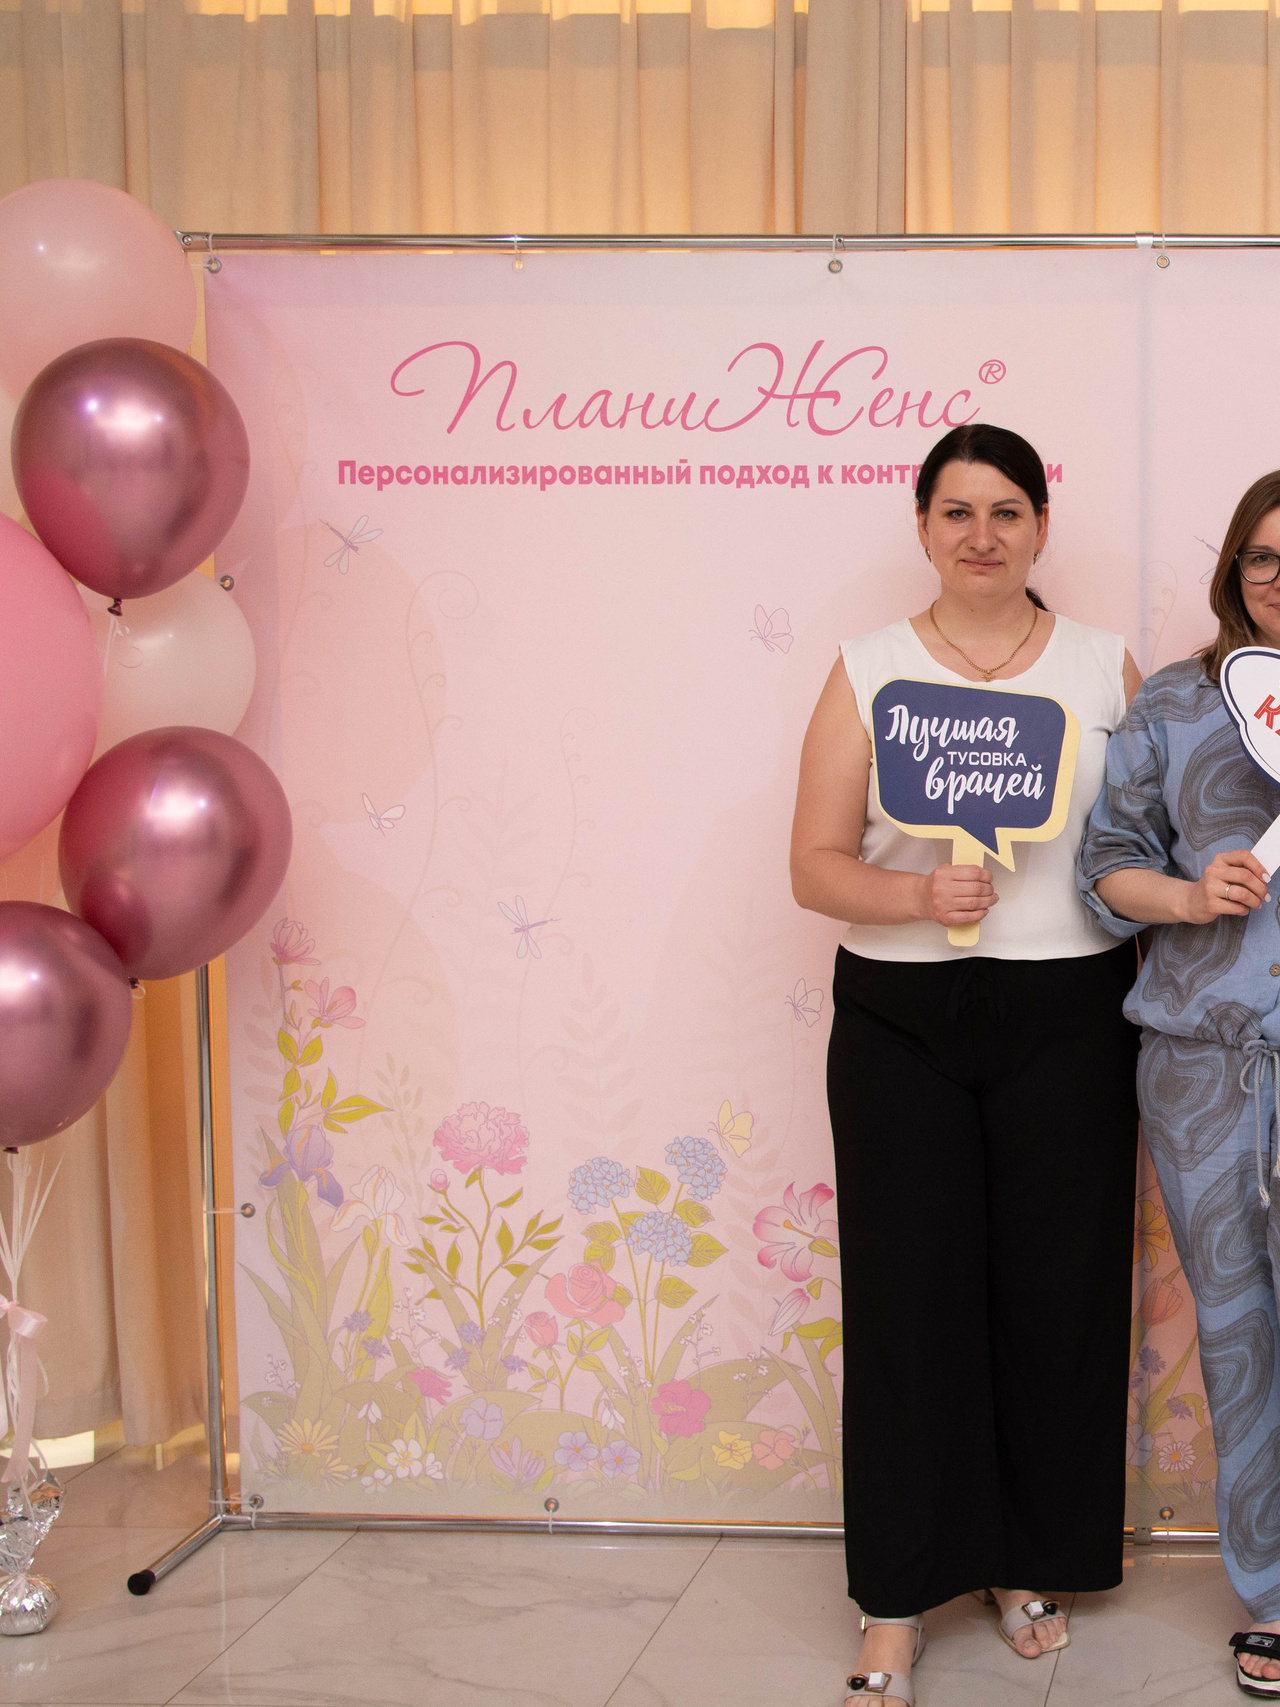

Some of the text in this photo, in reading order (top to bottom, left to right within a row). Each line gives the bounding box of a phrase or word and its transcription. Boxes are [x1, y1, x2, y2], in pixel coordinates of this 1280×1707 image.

[337, 459, 692, 492] Персонализированный
[699, 464, 810, 491] подход
[817, 464, 834, 485] к
[885, 704, 1020, 762] Лучшая
[947, 751, 1028, 767] ТУСОВКА
[925, 756, 1046, 815] врачей
